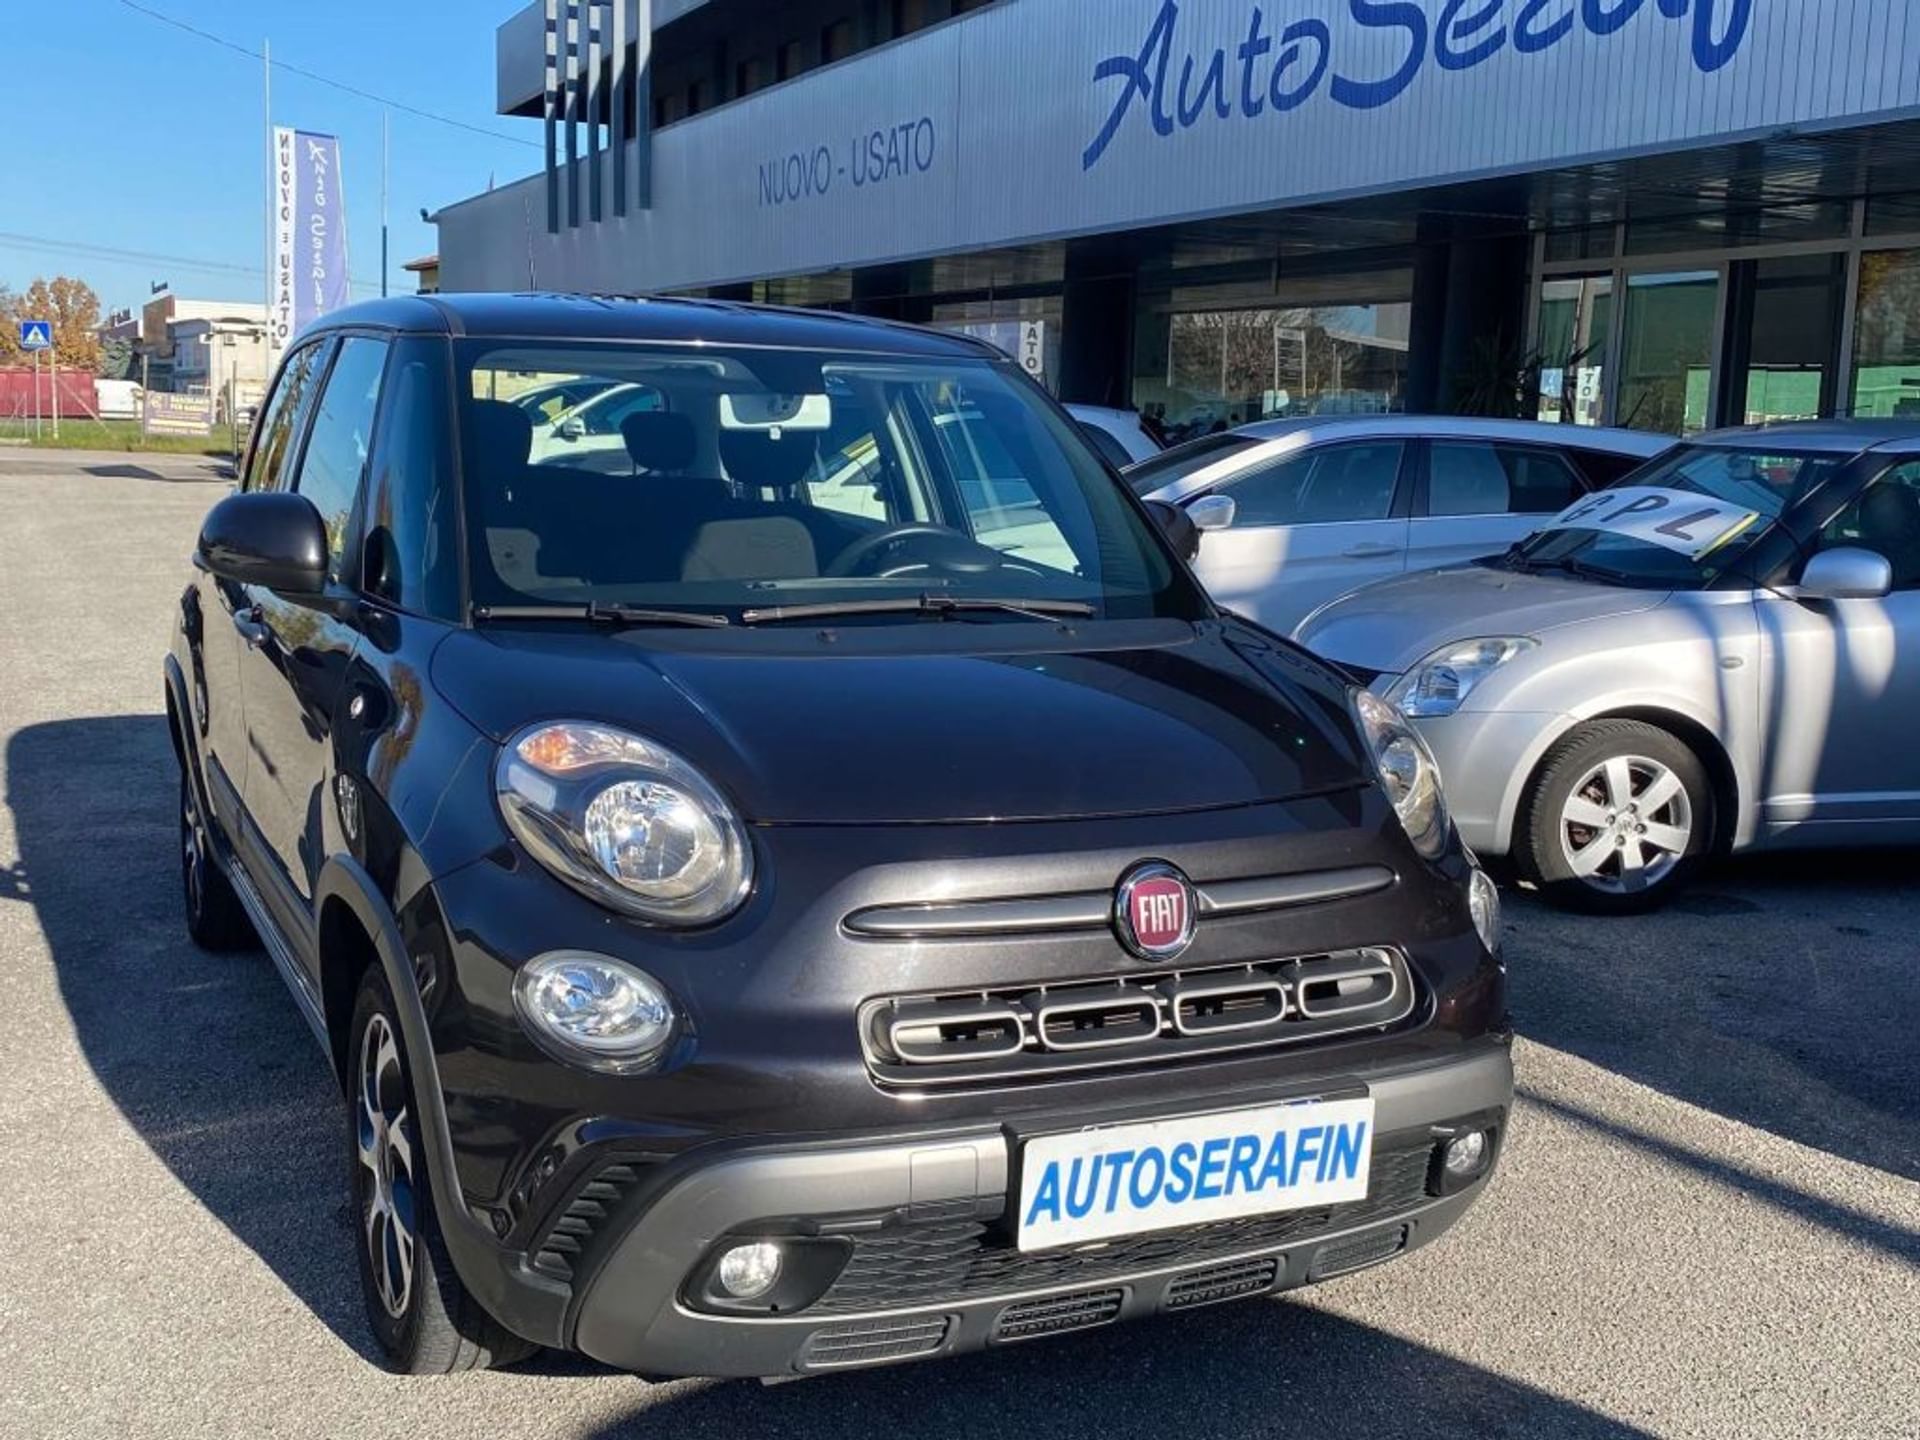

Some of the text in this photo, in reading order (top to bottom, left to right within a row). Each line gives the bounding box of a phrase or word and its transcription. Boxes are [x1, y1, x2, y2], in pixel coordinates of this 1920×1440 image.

[759, 145, 831, 207] NUOVO
[852, 116, 935, 187] USATO
[1138, 892, 1181, 934] FIAT
[1025, 1121, 1366, 1226] AUTOSERAFIN
